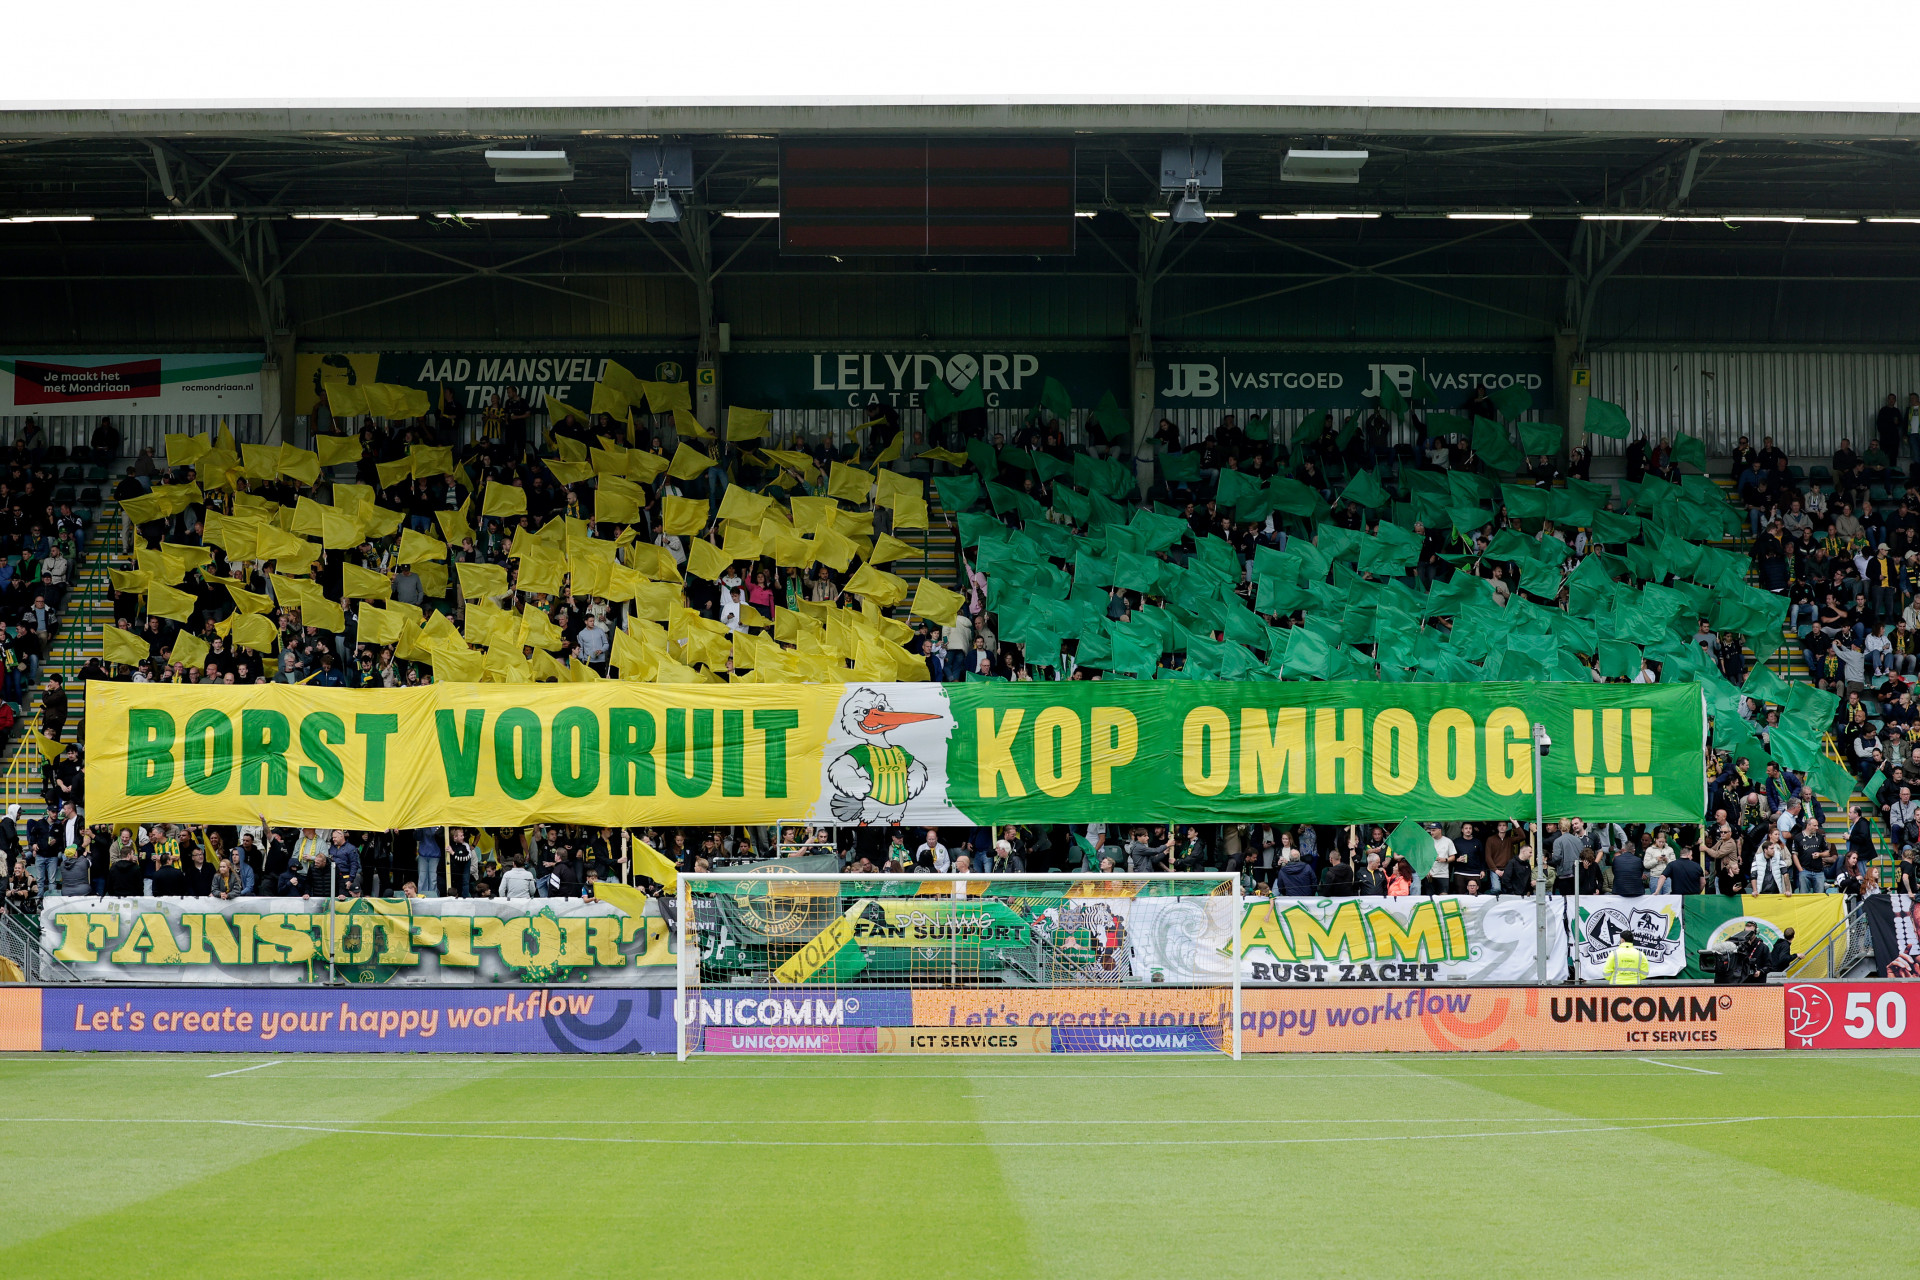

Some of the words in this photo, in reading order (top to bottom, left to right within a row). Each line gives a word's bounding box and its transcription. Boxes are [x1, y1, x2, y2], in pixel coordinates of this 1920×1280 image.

[43, 371, 58, 382] Je
[61, 371, 99, 382] maakt
[101, 371, 120, 381] het
[417, 358, 471, 382] AAD
[699, 369, 713, 384] G
[1575, 370, 1587, 385] F
[43, 384, 60, 393] met
[62, 382, 131, 393] Mondriaan
[181, 383, 255, 393] rocmondriaan.nl
[1229, 372, 1344, 390] VASTGOED
[1429, 372, 1542, 390] VASTGOED
[848, 392, 1000, 408] CATEG
[125, 708, 399, 802] BORST
[434, 706, 799, 801] VOORUIT
[976, 706, 1139, 798] KOP
[1181, 705, 1535, 798] OMHOOG
[668, 899, 712, 908] SPRE
[667, 918, 716, 931] PSENTI
[742, 911, 762, 930] FAN
[763, 906, 806, 934] SUPPORT
[1637, 921, 1660, 931] FAN
[854, 923, 906, 939] FAN
[914, 924, 1026, 941] SUPPORT
[781, 924, 843, 983] WOLF
[1252, 962, 1328, 982] RUST
[1339, 963, 1439, 982] ZACHT
[74, 1003, 145, 1031] Let's
[152, 1006, 253, 1032] create
[260, 1010, 333, 1040] your
[338, 1002, 439, 1038] happy
[447, 989, 595, 1030] workflow
[673, 998, 844, 1026] UNICOMM
[1028, 1007, 1130, 1026] create
[1219, 1003, 1316, 1037] happy
[1327, 988, 1472, 1027] workflow
[1550, 996, 1718, 1023] UNICOMM
[1843, 991, 1907, 1040] 50
[731, 1034, 823, 1049] UNICOMM
[910, 1034, 938, 1048] ICT
[940, 1034, 1018, 1048] SERVICES
[1098, 1034, 1188, 1048] UNICOMM
[1626, 1031, 1649, 1043] ICT
[1652, 1030, 1718, 1042] SERVICES
